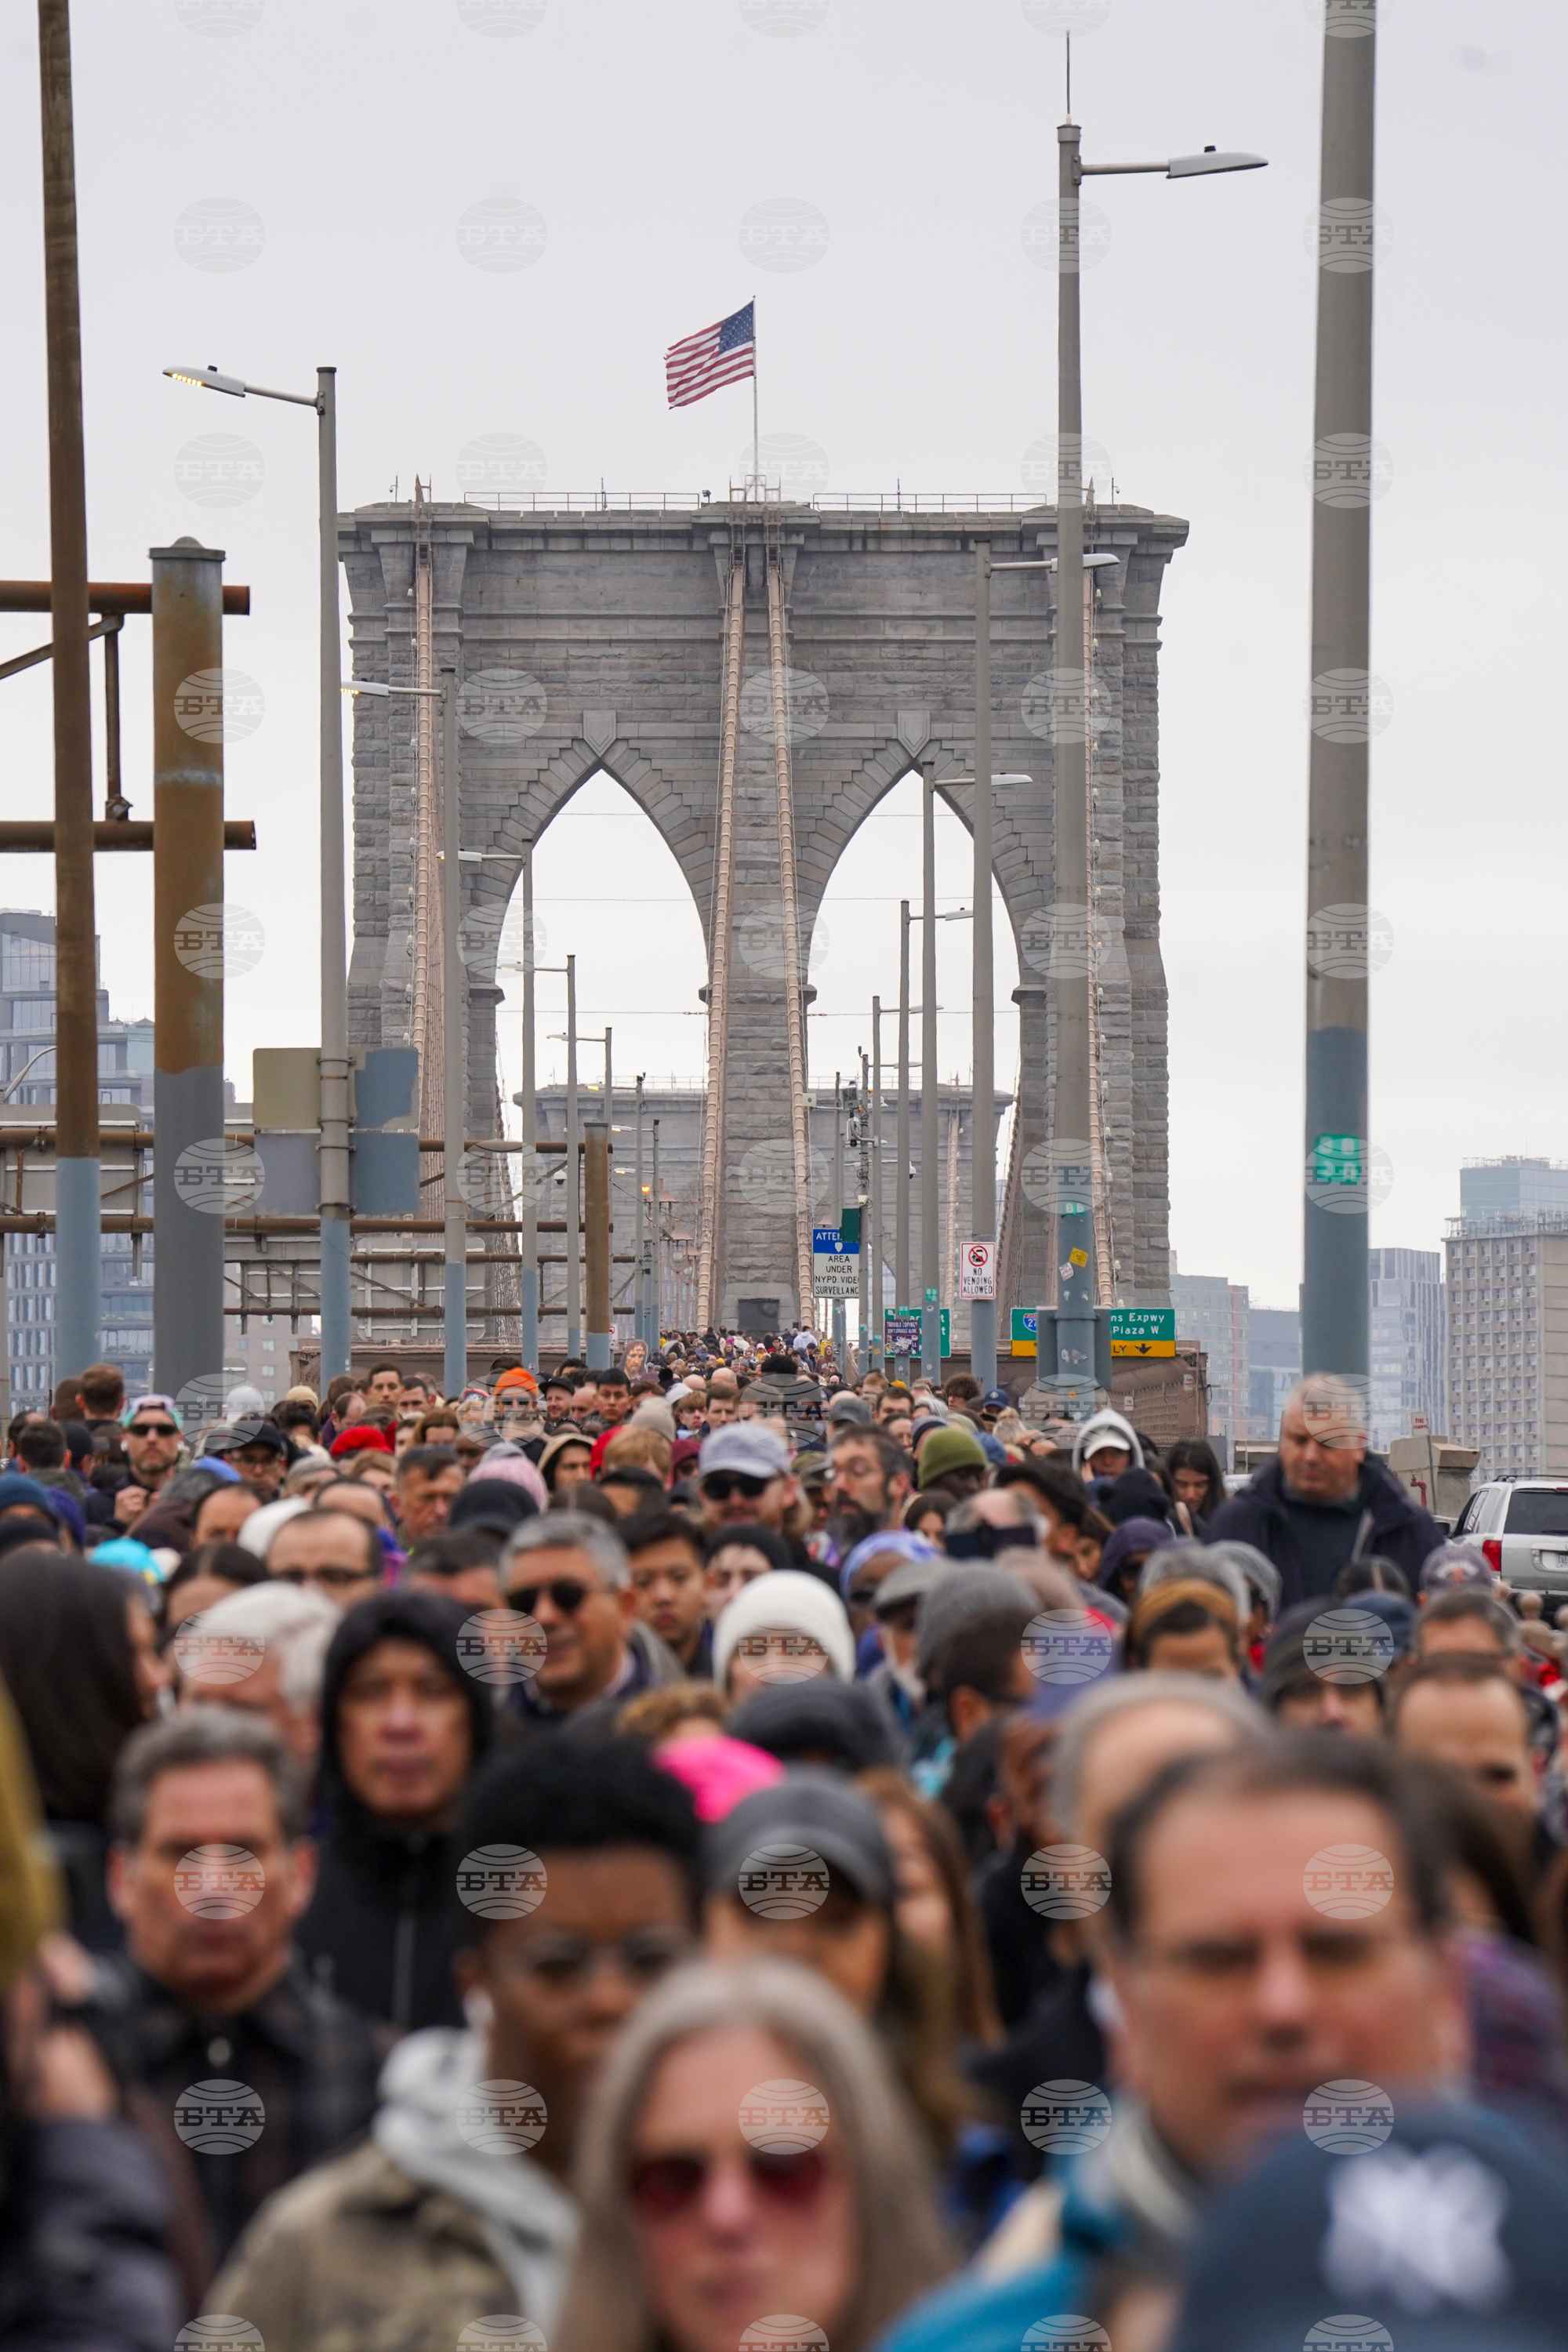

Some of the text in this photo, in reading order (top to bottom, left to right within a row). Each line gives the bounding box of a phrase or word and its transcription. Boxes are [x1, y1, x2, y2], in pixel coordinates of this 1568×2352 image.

[1129, 1312, 1165, 1323] Expwy
[1112, 1325, 1160, 1334] Plaza W
